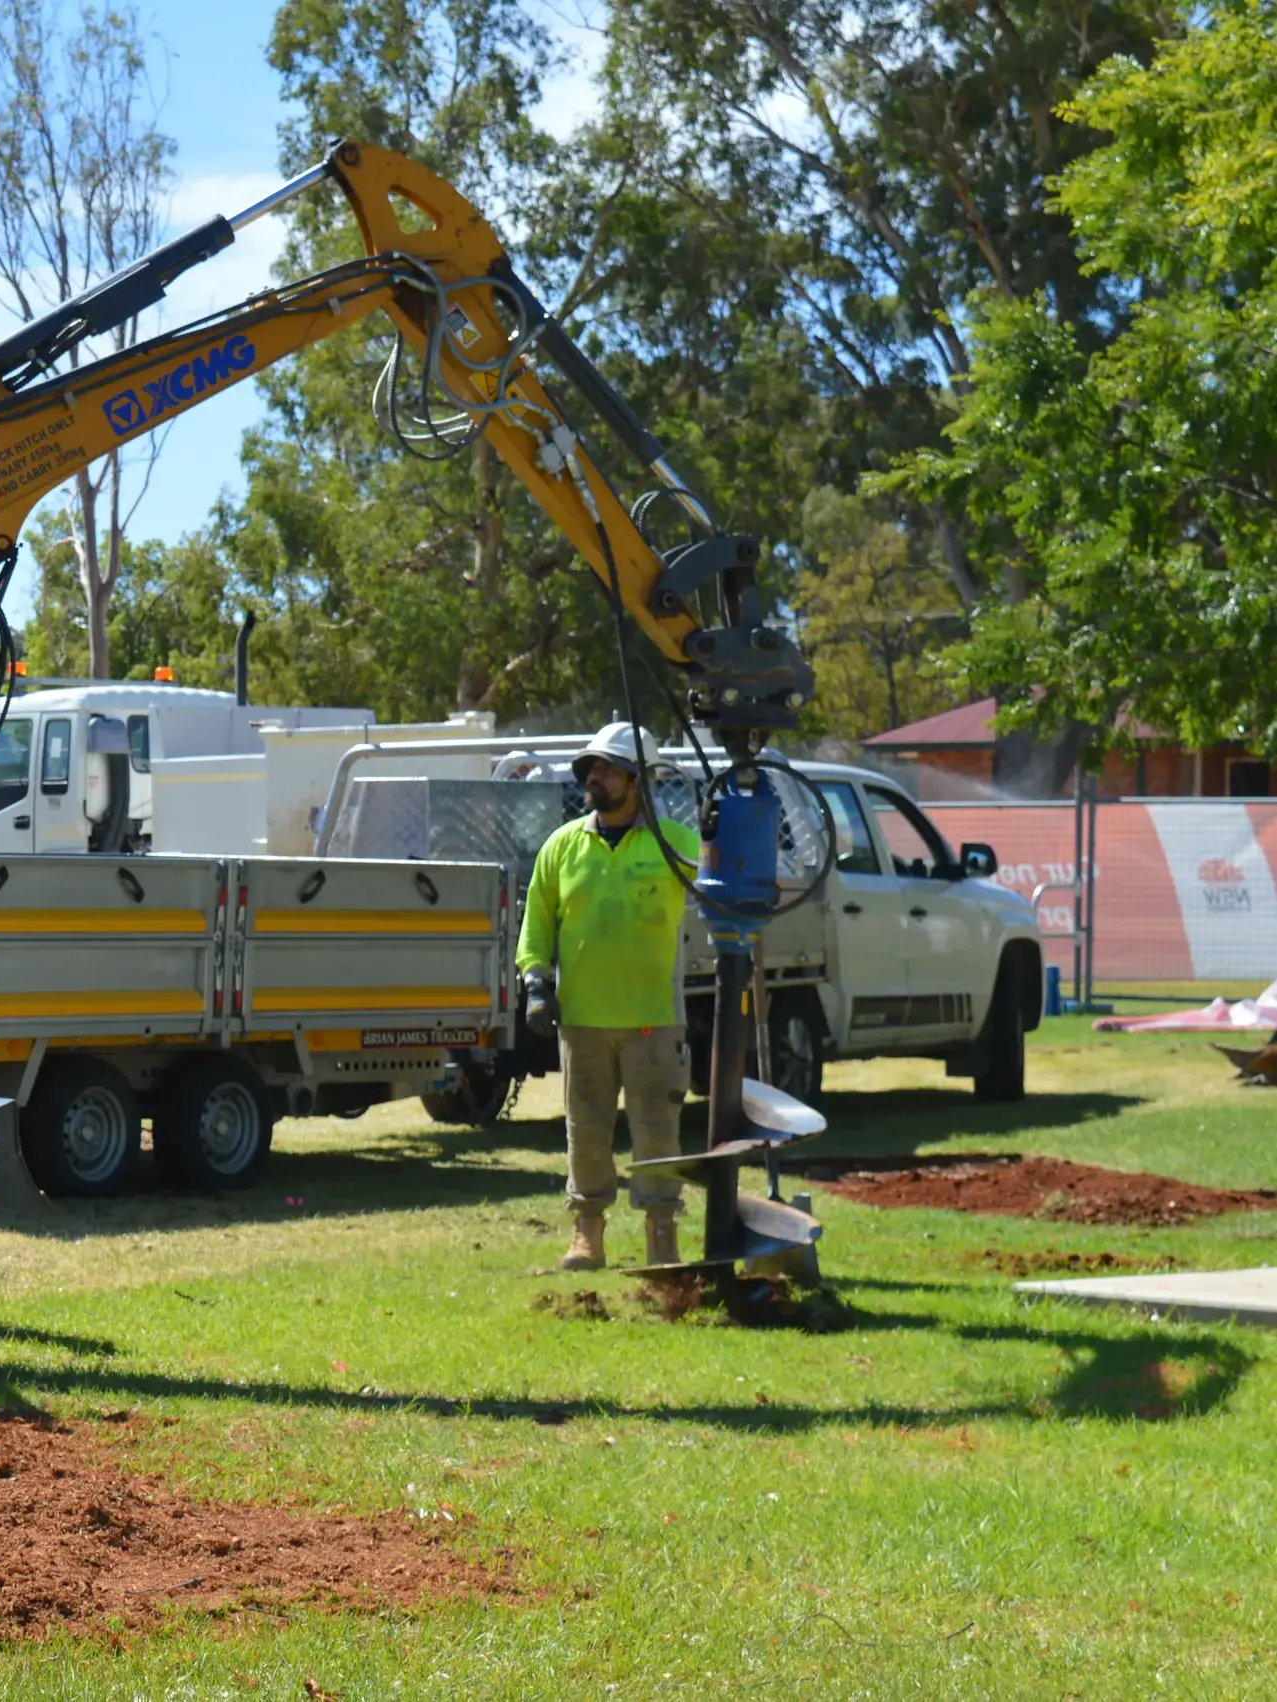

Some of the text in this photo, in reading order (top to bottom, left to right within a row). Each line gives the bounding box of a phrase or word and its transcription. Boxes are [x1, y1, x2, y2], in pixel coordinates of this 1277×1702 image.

[141, 335, 256, 420] XCMG
[14, 428, 47, 454] HITCH
[47, 414, 75, 436] ONLY
[18, 460, 53, 485] CARRY
[364, 1029, 477, 1046] BRIAN JAMES TRAILERS
